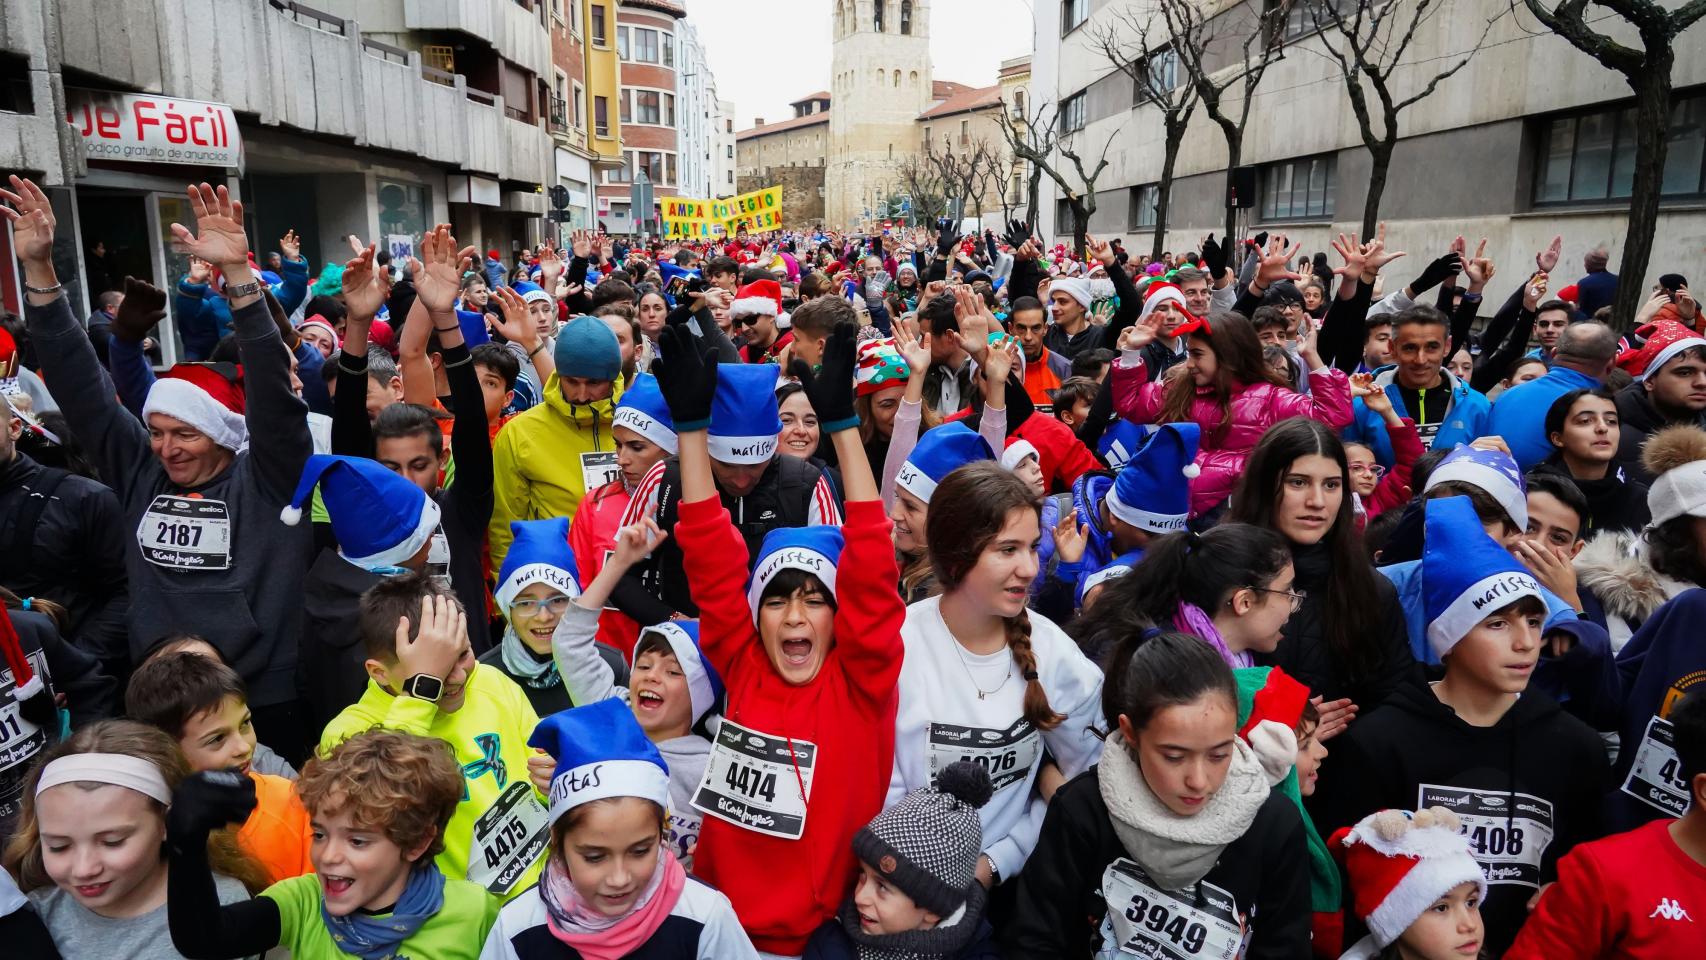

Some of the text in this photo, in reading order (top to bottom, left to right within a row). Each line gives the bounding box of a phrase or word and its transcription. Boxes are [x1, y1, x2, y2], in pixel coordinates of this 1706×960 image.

[133, 100, 228, 148] Fácil
[124, 145, 165, 159] gratuito
[168, 147, 182, 158] de
[185, 150, 228, 162] anuncios
[669, 193, 773, 219] AMPA COLEGIO
[663, 221, 708, 236] SANTA
[156, 522, 202, 547] 2187
[516, 566, 571, 589] maristas
[760, 551, 824, 583] maristas
[935, 730, 959, 738] LABORAL
[725, 762, 777, 803] 4474
[1427, 795, 1456, 804] LABORAL
[484, 815, 528, 869] 4475
[1126, 895, 1208, 954] 3949
